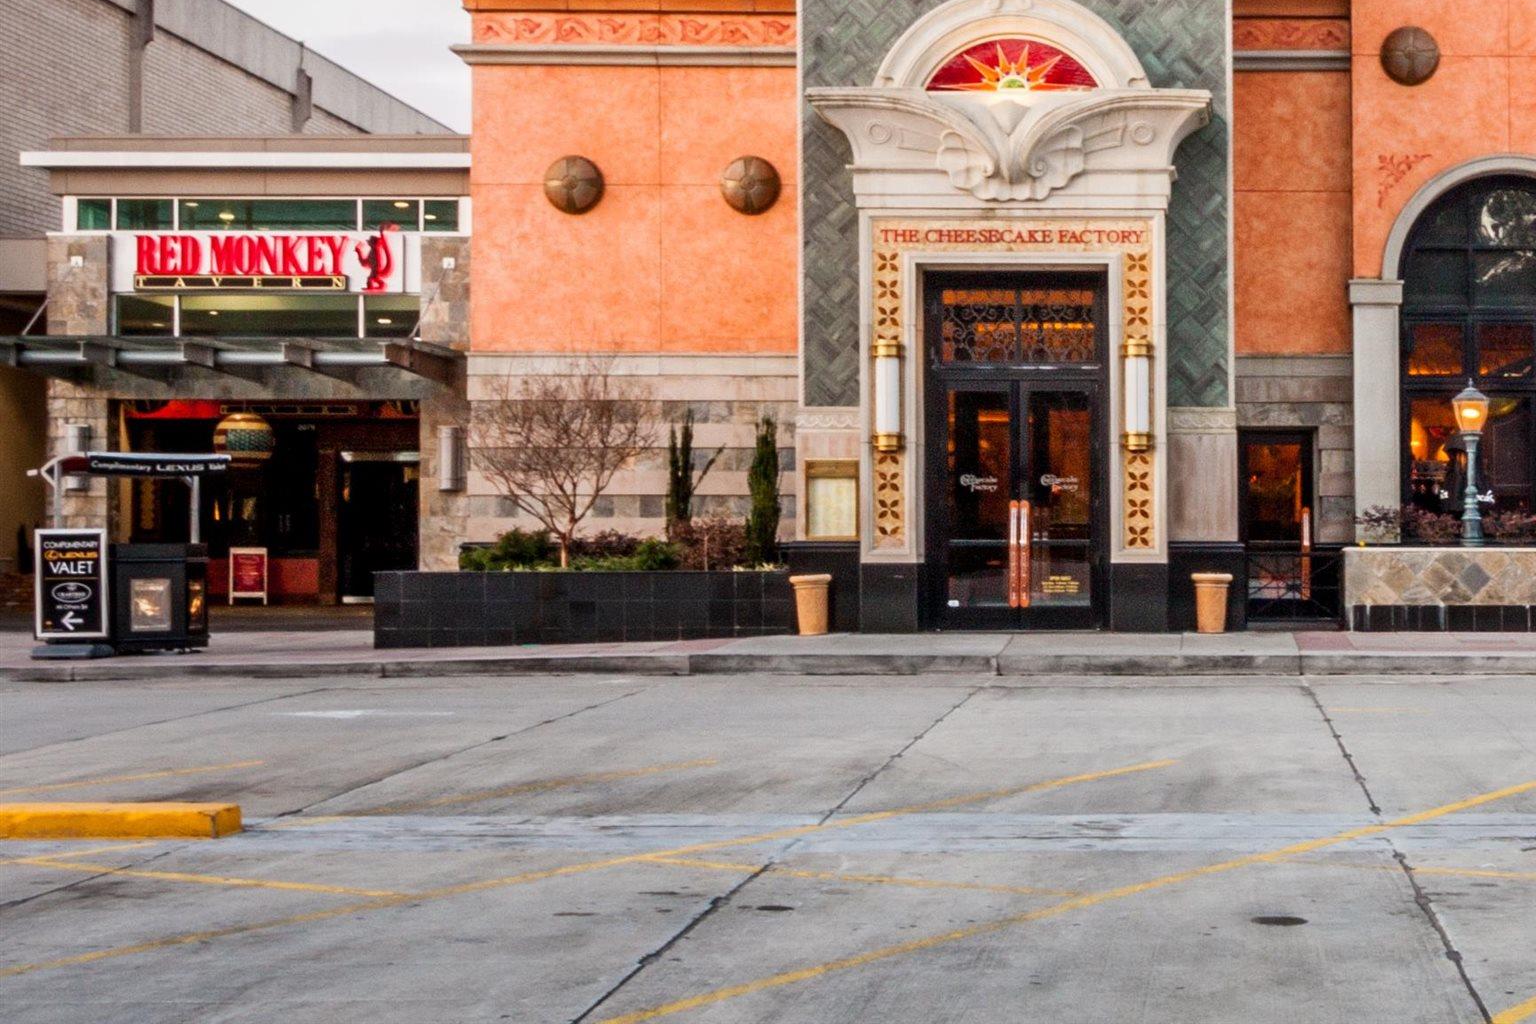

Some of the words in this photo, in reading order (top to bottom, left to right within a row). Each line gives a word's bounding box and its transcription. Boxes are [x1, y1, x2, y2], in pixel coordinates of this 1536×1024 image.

[880, 229, 920, 244] THE
[925, 229, 1054, 244] CHEESECAKE
[1057, 229, 1145, 244] FACTORY
[135, 234, 201, 276] RED
[210, 234, 349, 276] MONKEY
[136, 276, 345, 289] TAVERN
[91, 460, 152, 473] Complimentary
[156, 464, 205, 472] LEXUS
[43, 541, 98, 549] COMPLIMENTARY
[60, 551, 98, 559] LEXUS
[49, 561, 94, 574] VALET
